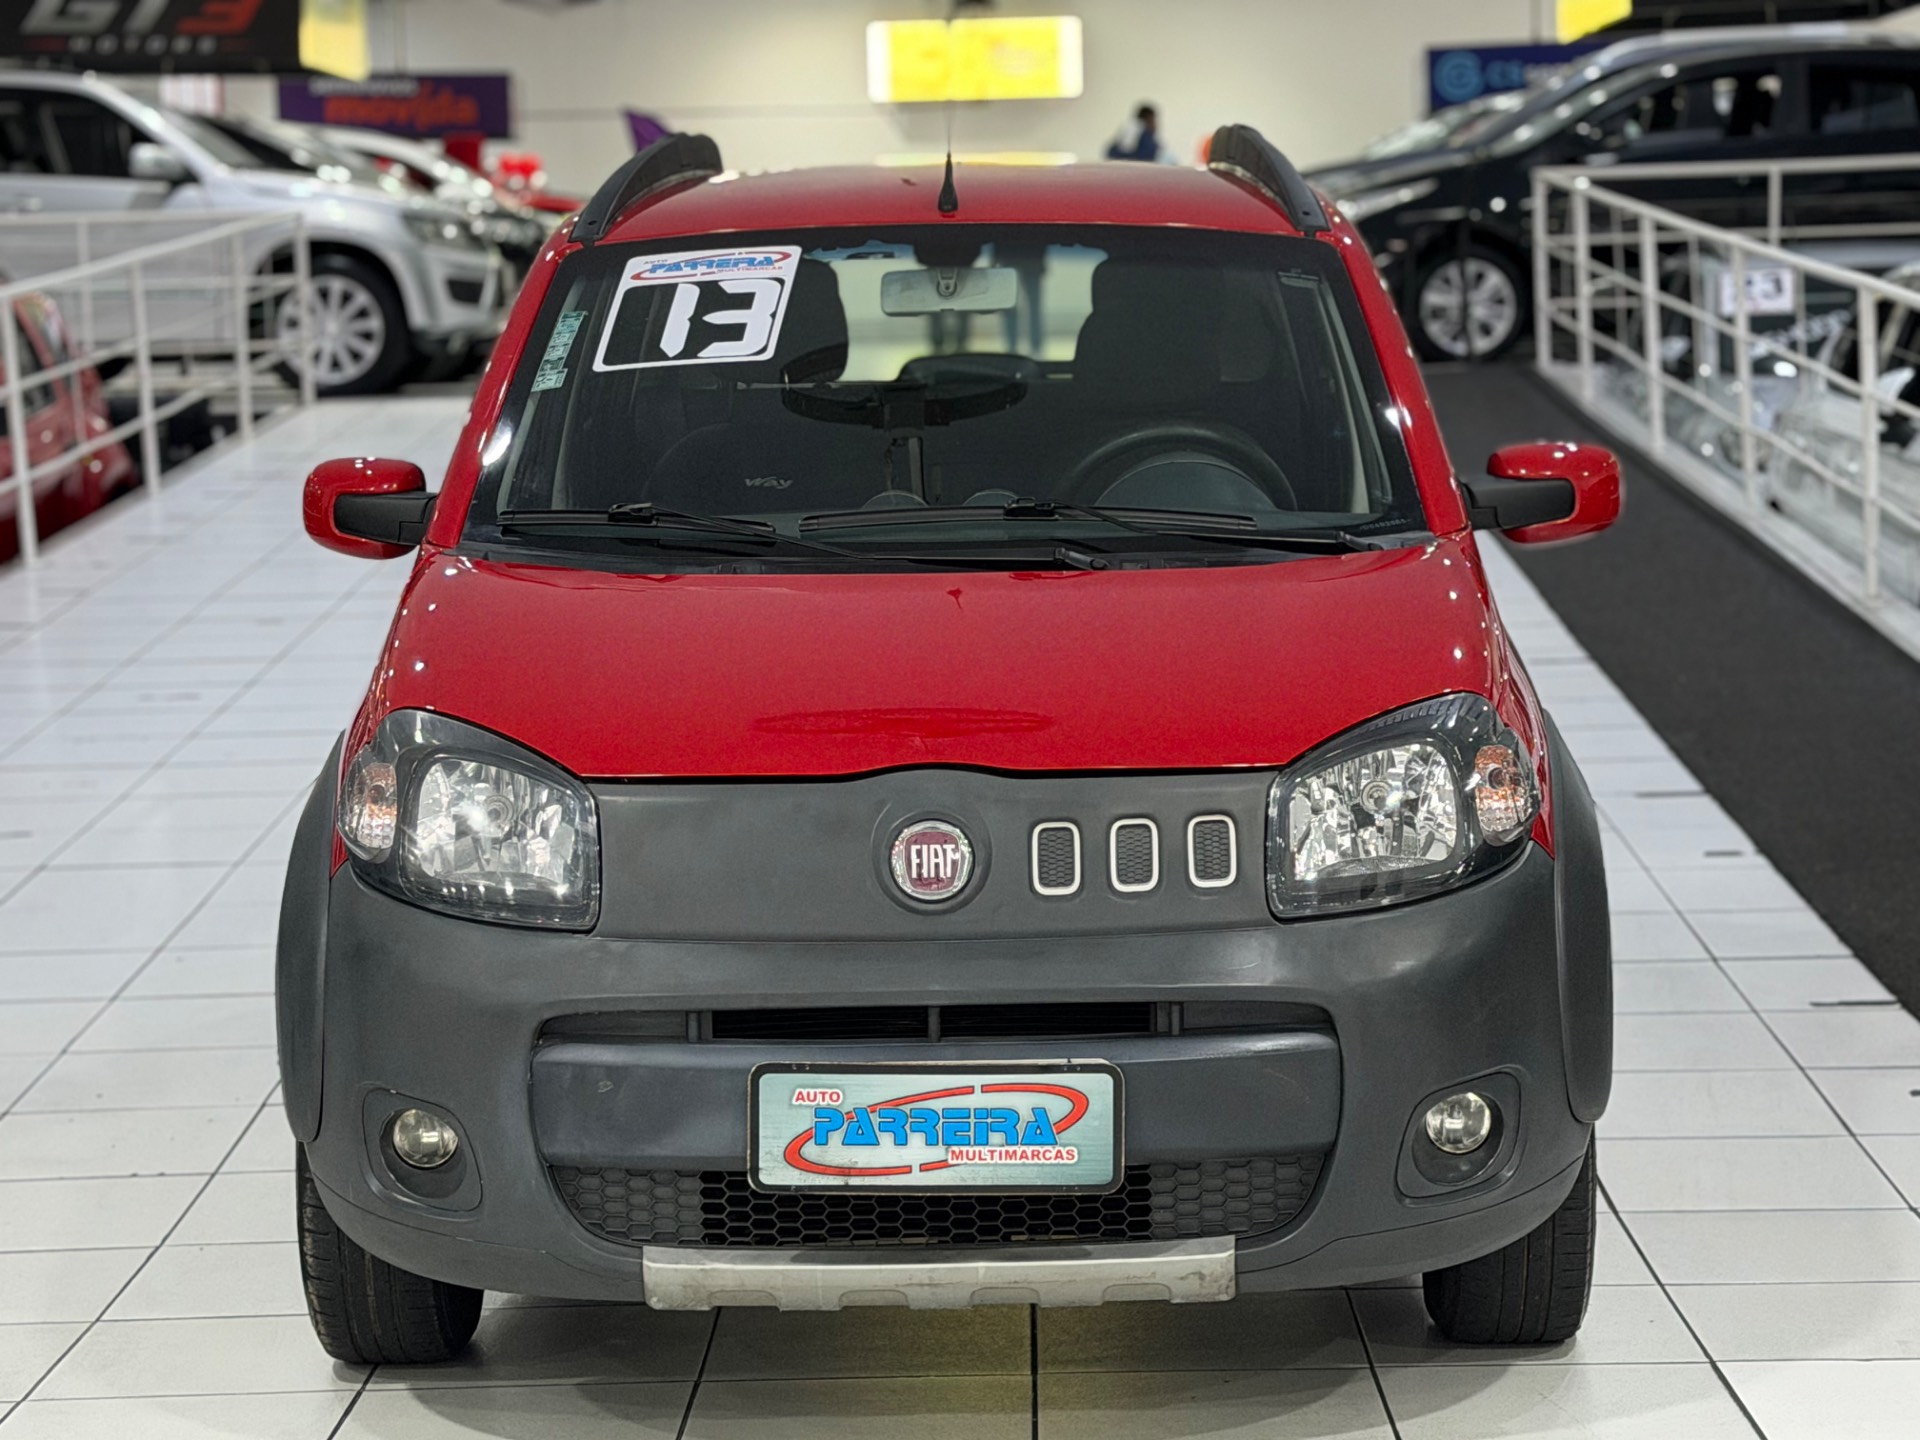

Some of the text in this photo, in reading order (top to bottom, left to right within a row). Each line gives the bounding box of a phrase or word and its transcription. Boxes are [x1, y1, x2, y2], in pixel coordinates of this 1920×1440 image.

[660, 278, 782, 358] 13
[911, 844, 956, 878] FIAT
[794, 1090, 841, 1103] AUTO
[813, 1107, 1059, 1146] PARREIRA
[949, 1148, 1076, 1162] MULTIMARCAS
